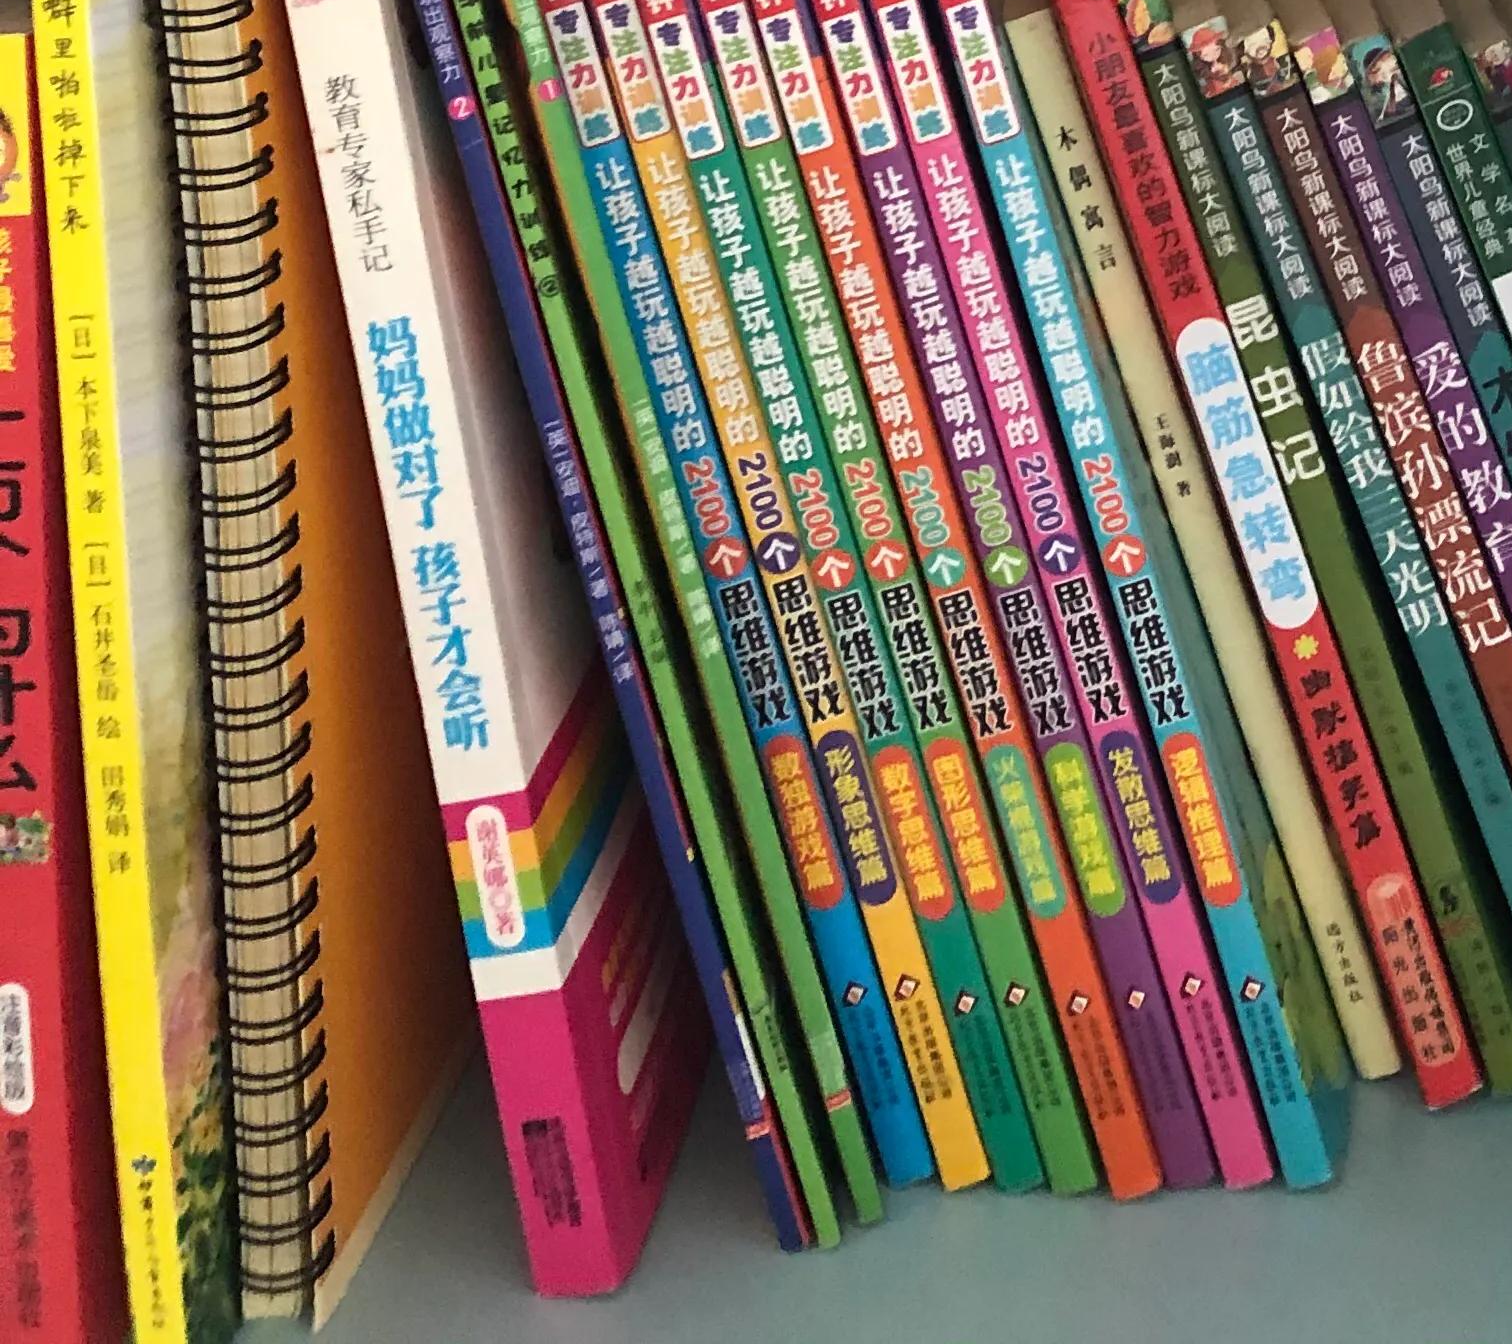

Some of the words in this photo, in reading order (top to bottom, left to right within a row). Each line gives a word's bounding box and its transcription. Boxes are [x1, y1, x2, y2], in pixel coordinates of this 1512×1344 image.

[553, 9, 621, 142] 专注力
[604, 2, 669, 135] 专注力
[659, 20, 716, 153] 专注力
[711, 8, 776, 140] 专注力
[764, 18, 828, 148] 专注力
[829, 18, 895, 149] 专注力
[883, 3, 949, 137] 专注力
[952, 3, 1016, 138] 专注力
[325, 75, 395, 273] 教育专家私手记
[1055, 124, 1117, 273] 木偶寓言
[1277, 107, 1364, 304] 太阳鸟新课标大阅读
[1330, 114, 1423, 307] 太阳鸟新课标大阅读
[1401, 134, 1494, 329] 太阳鸟新课标大阅读
[1445, 141, 1504, 260] 世界儿童经典
[1154, 63, 1239, 258] 太阳鸟新课标大阅读
[1224, 295, 1328, 483] 昆虫记
[1223, 107, 1311, 302] 太阳鸟新课标大阅读
[1300, 330, 1452, 637] 假如给我三天光明
[366, 316, 446, 526] 妈妈做对了
[412, 546, 492, 753] 孩子才会听
[1183, 340, 1307, 605] 脑筋急转弯
